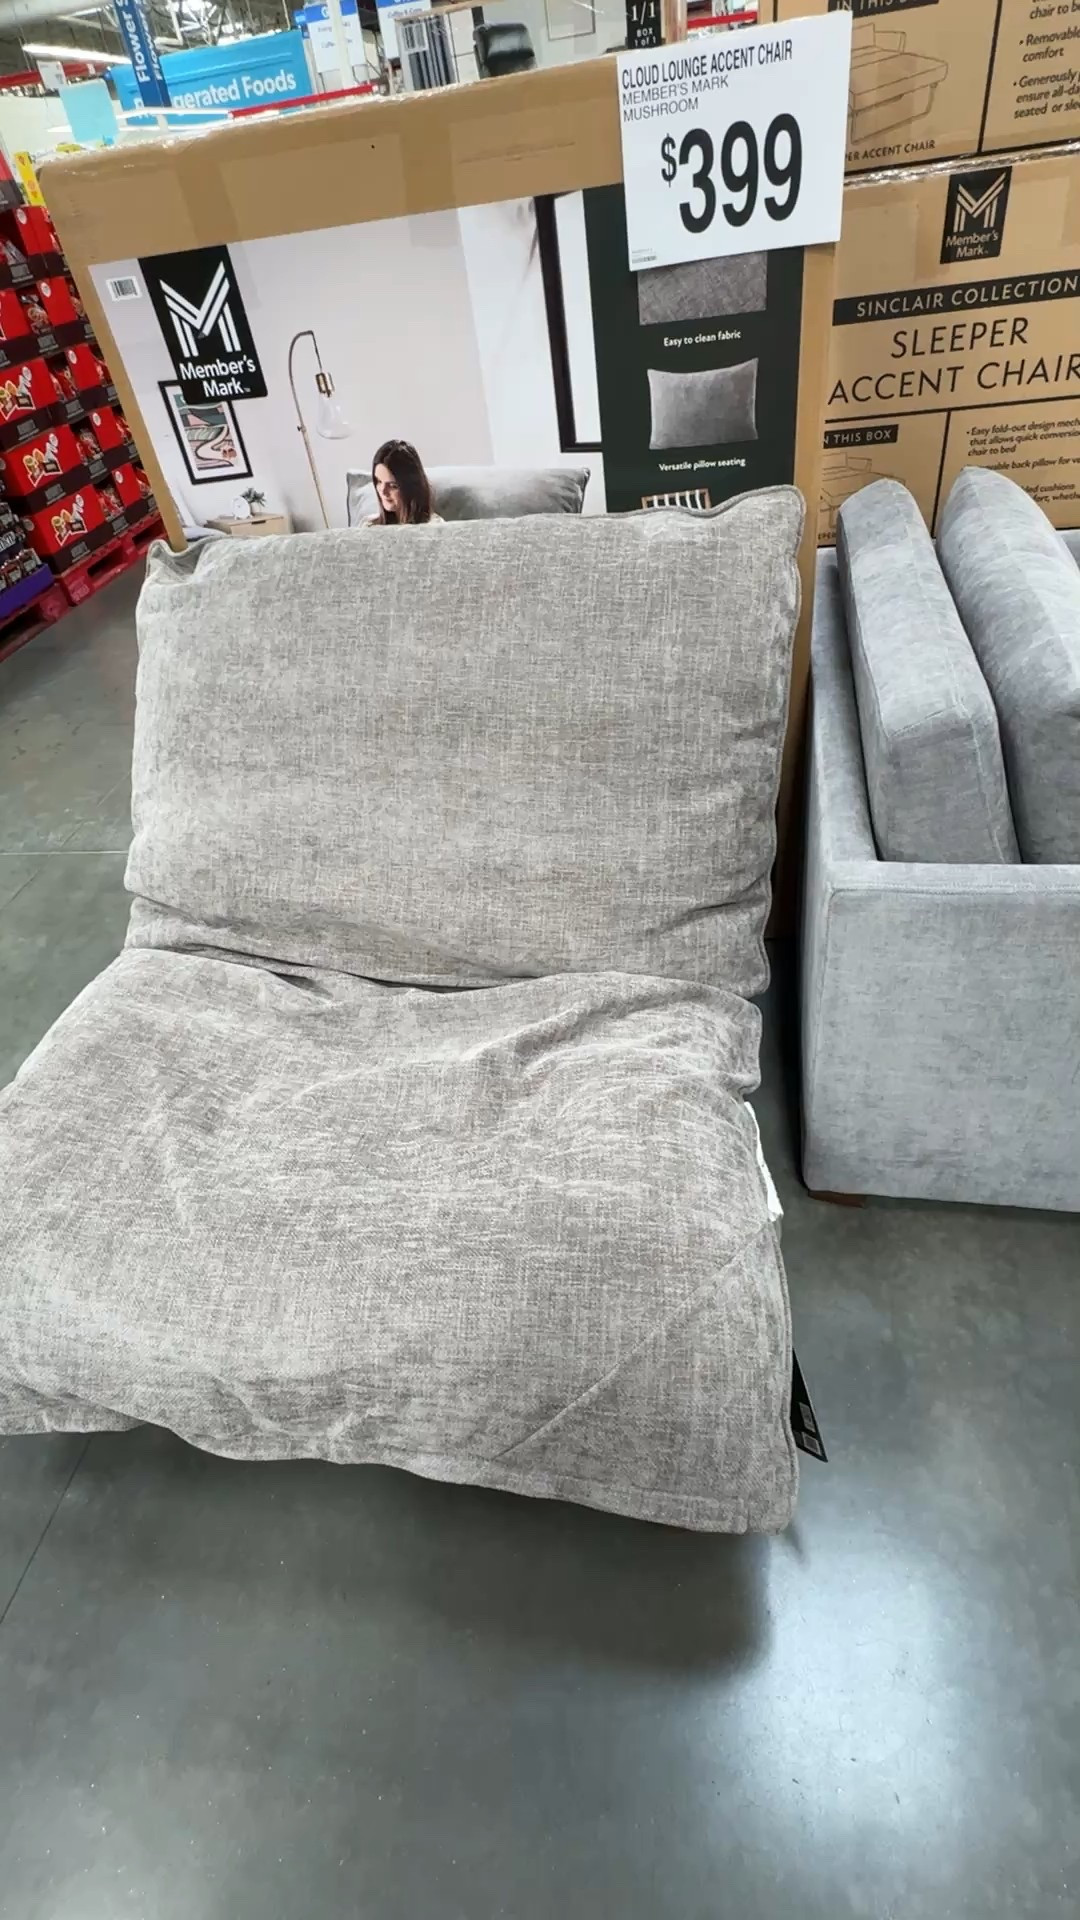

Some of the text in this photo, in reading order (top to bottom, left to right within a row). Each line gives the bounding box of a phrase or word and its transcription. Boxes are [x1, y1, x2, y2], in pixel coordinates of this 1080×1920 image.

[1029, 5, 1055, 19] chair
[1057, 5, 1069, 15] to
[636, 27, 654, 38] BOX
[122, 10, 151, 82] Flower
[1022, 46, 1064, 62] comfort
[622, 39, 793, 89] CLOUD LOUNGE ACCENT CHAIR
[241, 69, 297, 98] Foods
[1019, 68, 1077, 88] Generously
[622, 75, 729, 105] MEMBER'S MARK
[1016, 91, 1050, 103] ensure
[622, 98, 699, 122] MUSHROOM
[1014, 102, 1048, 119] seated
[1052, 104, 1063, 112] or
[862, 145, 902, 159] ACCENT
[904, 139, 935, 154] CHAIR
[661, 113, 802, 234] $399
[946, 230, 999, 247] Member's
[956, 244, 984, 258] Mark
[857, 276, 1078, 317] SINCLAIR COLLECTION
[663, 337, 682, 348] Easy
[694, 333, 716, 343] clean
[717, 330, 741, 340] fabric
[890, 317, 1028, 359] SLEEPER
[179, 354, 256, 380] Member's
[203, 377, 244, 397] Mark
[828, 353, 1080, 405] ACCENT CHAIR
[834, 432, 861, 444] THIS
[866, 430, 892, 441] BOX
[971, 426, 990, 436] Easy
[992, 424, 1026, 434] fold-out
[1028, 421, 1055, 431] design
[970, 438, 987, 446] that
[988, 436, 1014, 445] allows
[1015, 432, 1038, 444] quick
[968, 445, 988, 456] chair
[1000, 444, 1017, 454] bed
[658, 457, 746, 471] Versatile pillow seating
[1011, 461, 1031, 469] back
[1032, 458, 1057, 469] pillow
[1058, 456, 1071, 465] for
[1040, 483, 1075, 492] cushions
